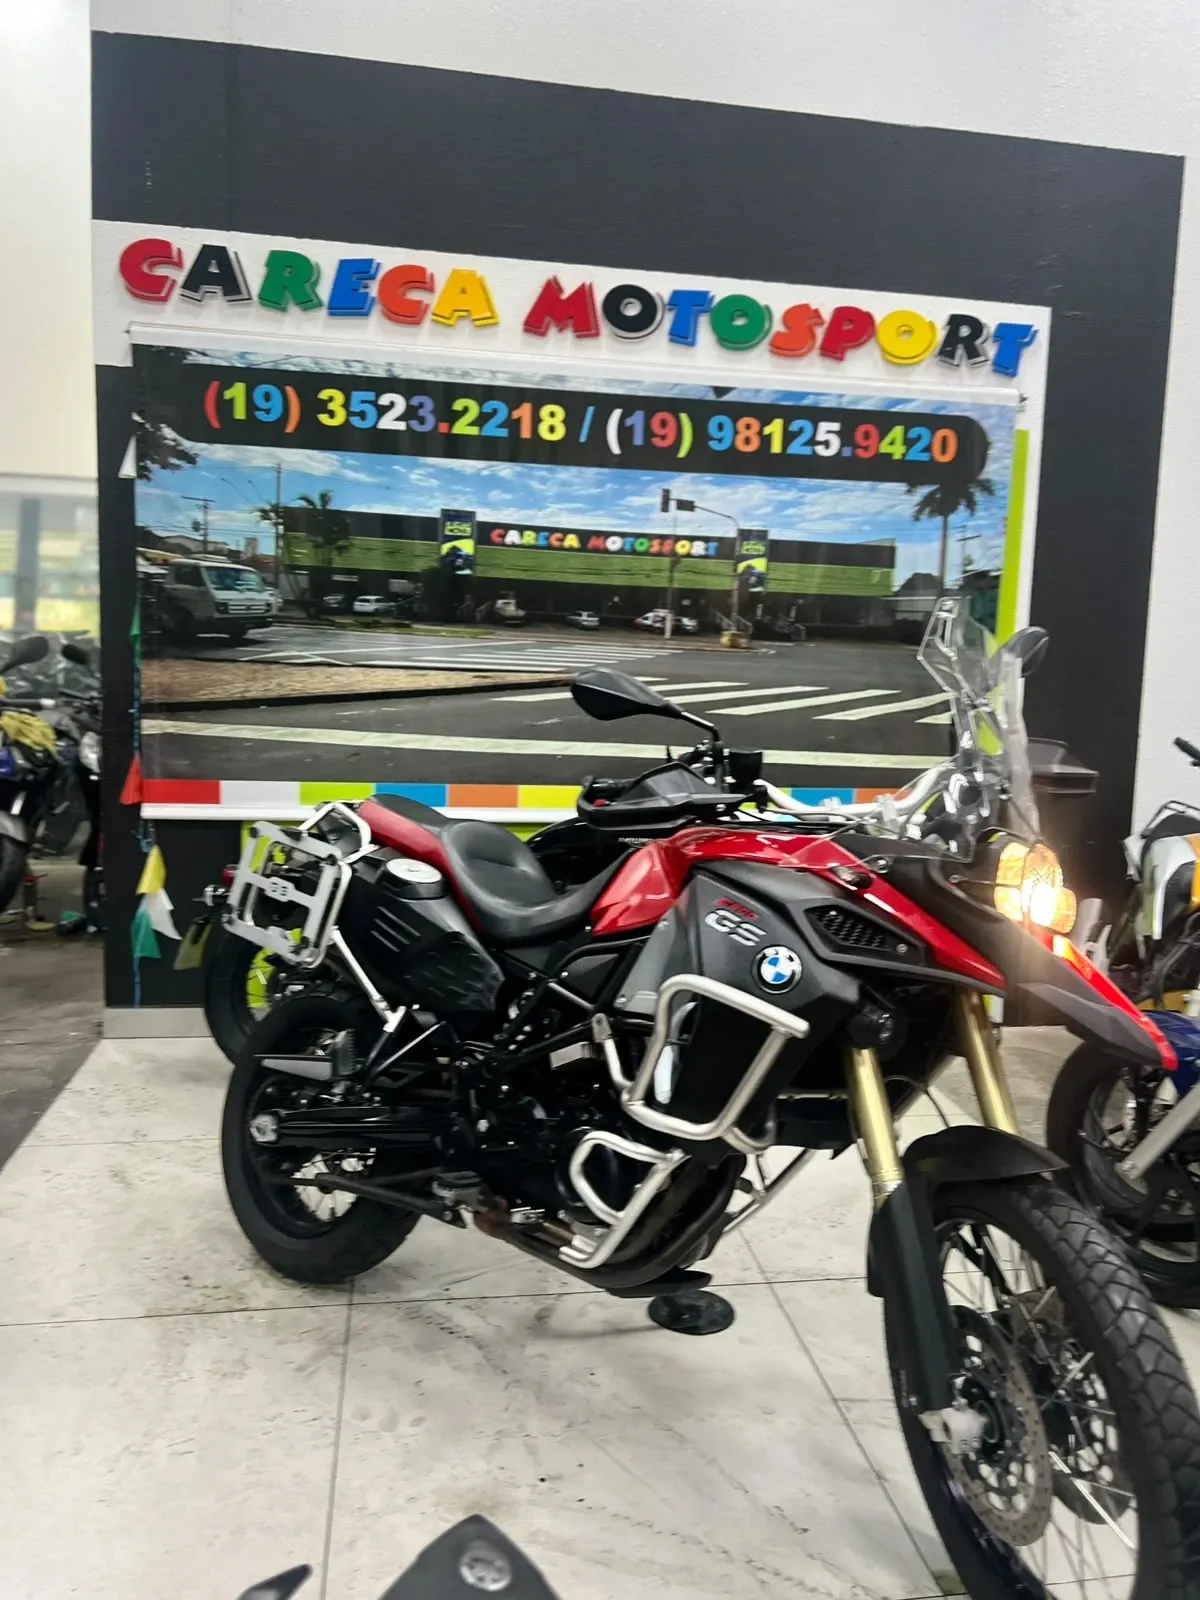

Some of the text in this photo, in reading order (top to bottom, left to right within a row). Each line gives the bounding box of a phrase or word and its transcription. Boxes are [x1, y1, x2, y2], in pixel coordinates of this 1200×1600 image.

[119, 238, 1038, 378] CARECA MOTOSPORT
[204, 380, 301, 434] (19)
[317, 388, 567, 442] 3523.2218
[606, 408, 693, 458] (19)
[707, 414, 958, 463] 98125.9420
[490, 528, 581, 549] CARECA
[704, 909, 768, 946] GS
